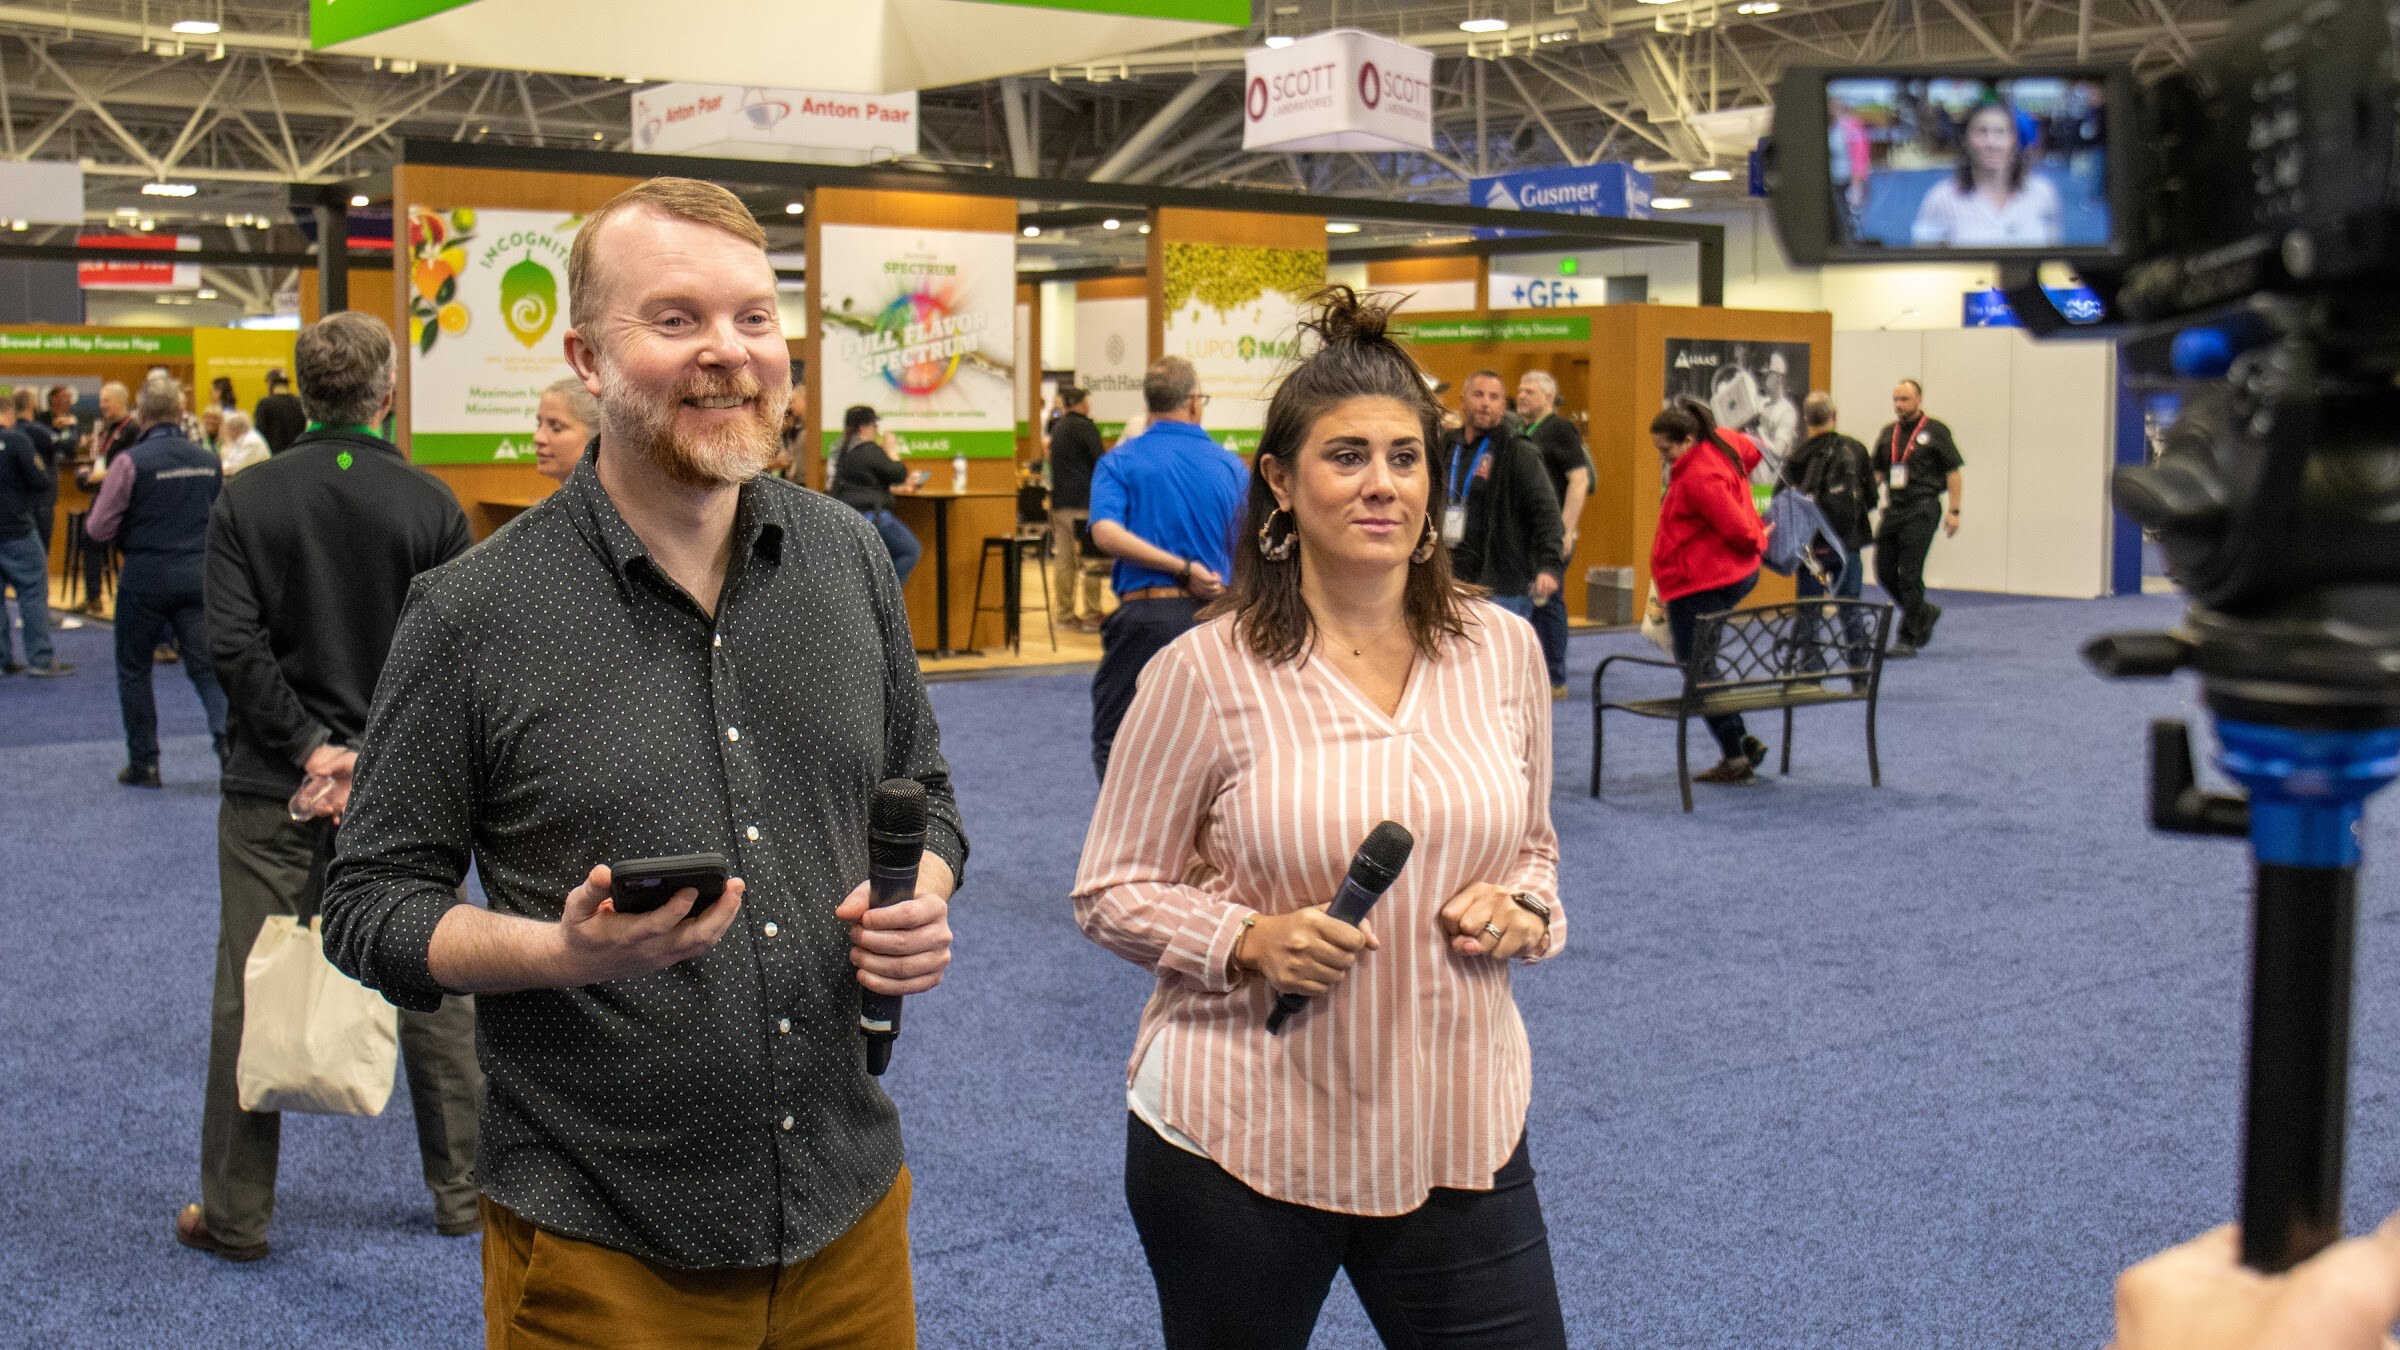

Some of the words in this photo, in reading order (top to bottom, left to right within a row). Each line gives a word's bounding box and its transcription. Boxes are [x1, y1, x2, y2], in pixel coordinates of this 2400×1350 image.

[1272, 62, 1336, 101] SCOTT
[1384, 71, 1430, 107] SCOTT
[666, 104, 695, 122] Anton
[698, 95, 724, 113] Paar
[802, 98, 860, 119] Anton
[866, 103, 911, 123] Paar
[1520, 182, 1598, 207] Gusmer
[883, 261, 957, 276] SPECTRUM
[43, 335, 66, 349] with
[1689, 355, 1718, 366] HAAS
[469, 387, 526, 398] Maximum
[465, 402, 520, 414] Minimum
